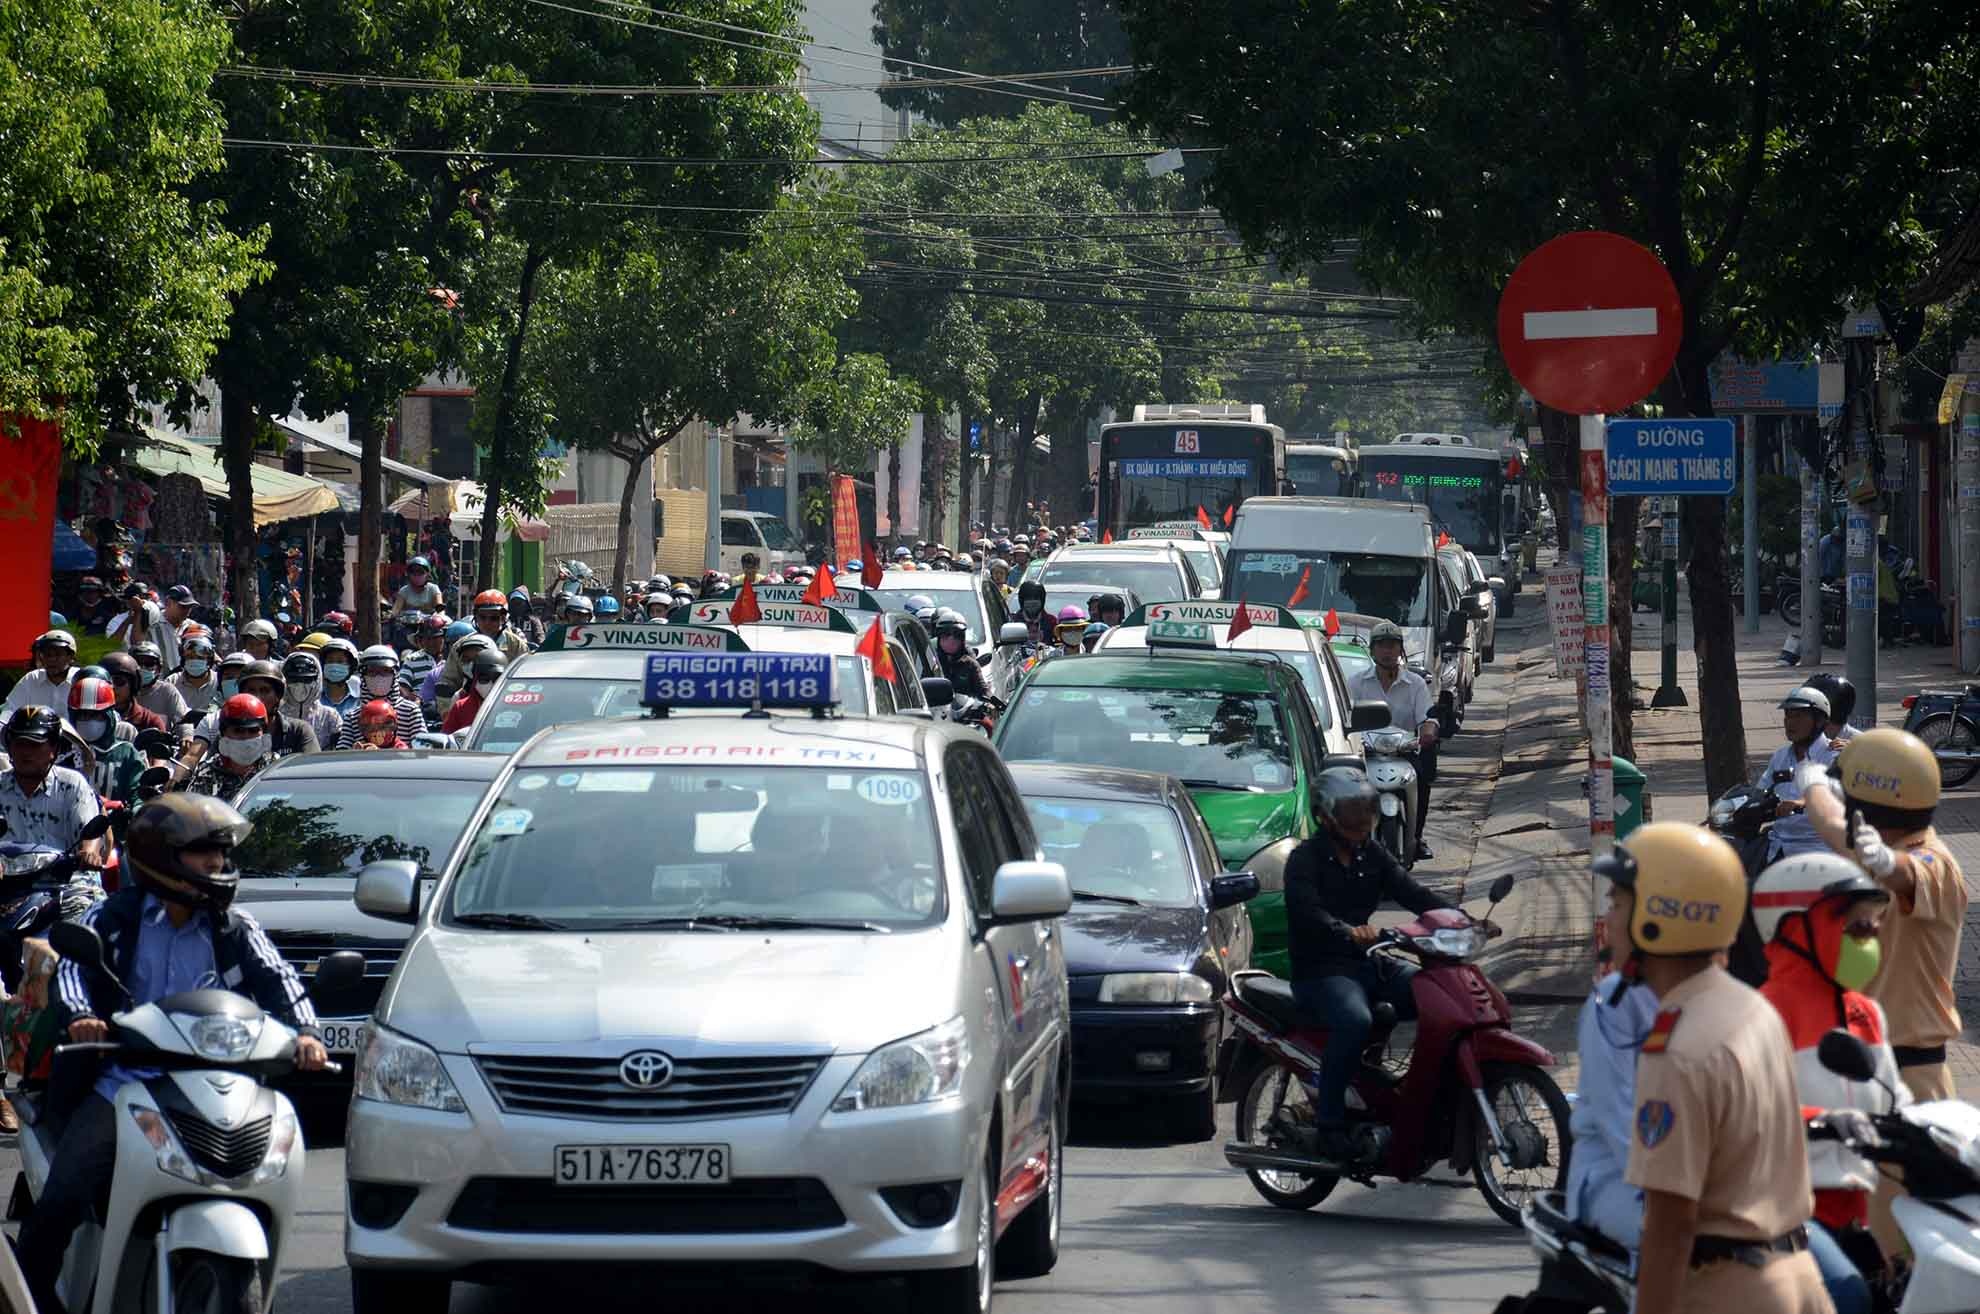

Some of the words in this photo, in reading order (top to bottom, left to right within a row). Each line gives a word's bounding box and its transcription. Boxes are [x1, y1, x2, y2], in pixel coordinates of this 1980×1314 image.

[1177, 431, 1197, 451] 45
[1637, 427, 1705, 447] ĐƯỜNG
[1609, 454, 1640, 480] CÁCH
[1645, 458, 1678, 484] MẠNG
[1681, 454, 1721, 480] THÁNG
[1723, 459, 1732, 480] 8
[781, 658, 823, 672] TAXI
[657, 679, 696, 699] 38
[705, 679, 756, 699] 118
[766, 679, 818, 698] 118
[800, 749, 877, 761] TAXI
[864, 778, 914, 800] 1090
[1646, 895, 1721, 924] CSGT
[561, 1149, 723, 1181] 51A-763.78
